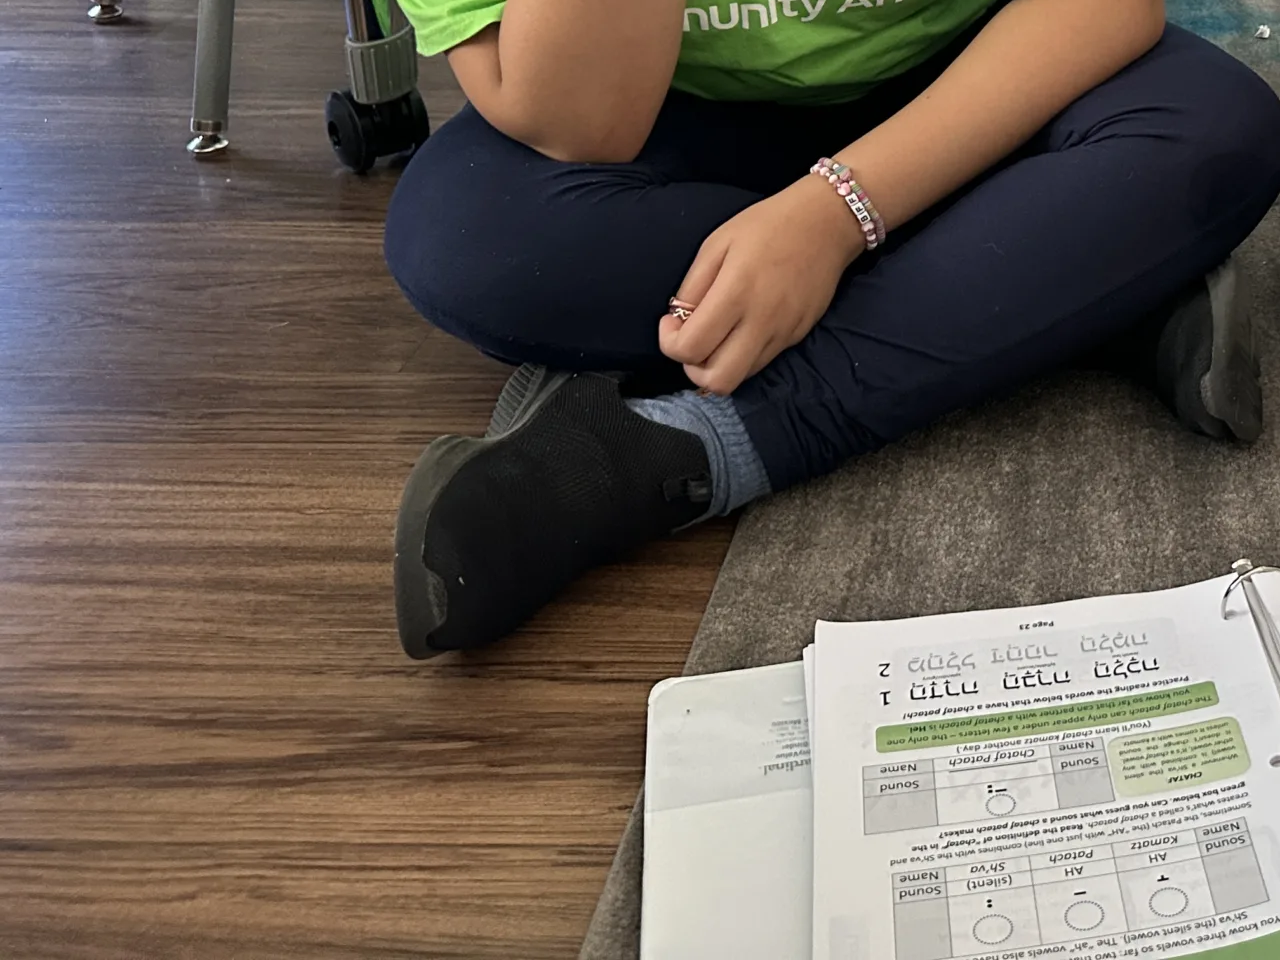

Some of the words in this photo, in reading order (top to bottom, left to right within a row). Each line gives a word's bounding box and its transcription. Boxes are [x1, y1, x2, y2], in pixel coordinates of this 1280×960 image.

[1032, 621, 1054, 629] Page
[878, 663, 890, 677] 2
[1152, 675, 1189, 687] Practice
[1097, 688, 1112, 696] the
[1114, 682, 1150, 693] reading
[880, 691, 892, 705] 1
[1033, 695, 1062, 704] below
[1065, 690, 1094, 700] words
[985, 702, 1009, 710] have
[1011, 700, 1031, 708] that
[903, 709, 940, 719] patach!
[942, 705, 974, 715] chataf
[1062, 729, 1093, 740] chataf
[1095, 726, 1120, 735] learn
[984, 739, 1021, 750] another
[1024, 736, 1059, 745] kamatz
[956, 744, 981, 753] day.)
[1059, 741, 1095, 752] Name
[949, 754, 991, 767] Patach
[994, 749, 1035, 761] Chataf
[764, 759, 812, 776] ardinal
[1060, 757, 1099, 769] Sound
[880, 764, 917, 774] Name
[1168, 772, 1202, 783] CHATAF
[880, 780, 919, 792] Sound
[1220, 781, 1245, 792] green
[1170, 793, 1200, 803] below.
[1202, 788, 1219, 798] box
[1217, 792, 1248, 804] creates
[1132, 801, 1149, 810] you
[1151, 799, 1168, 807] Can
[1080, 810, 1103, 818] what
[1105, 804, 1130, 814] guess
[1159, 806, 1184, 818] called
[1200, 802, 1252, 818] Sometimes,
[1050, 814, 1077, 823] sound
[1120, 812, 1149, 823] chataf
[1152, 817, 1182, 828] Patach
[1184, 815, 1199, 823] the
[976, 822, 1008, 834] patach
[1010, 819, 1040, 830] chataf
[1061, 823, 1083, 832] Read
[1132, 822, 1150, 831] (the
[1202, 822, 1240, 837] Name
[939, 827, 974, 839] makes?
[995, 829, 1040, 841] definition
[1042, 826, 1057, 835] the
[1084, 831, 1105, 840] with
[983, 836, 993, 844] of
[1046, 837, 1064, 845] one
[1066, 833, 1082, 842] just
[1131, 835, 1178, 851] Kamatz
[911, 845, 927, 853] the
[978, 843, 1022, 854] combines
[1024, 838, 1044, 849] line)
[1205, 835, 1246, 852] Sound
[937, 852, 952, 860] the
[955, 849, 975, 858] with
[1049, 850, 1094, 864] Patach
[1148, 852, 1167, 863] AH
[890, 857, 907, 866] and
[1064, 866, 1083, 876] AH
[899, 871, 939, 884] Name
[967, 874, 1012, 891] (silent)
[899, 886, 942, 900] Sound
[1194, 918, 1216, 930] (the
[1260, 915, 1280, 927] You
[1163, 922, 1192, 936] silent
[1229, 922, 1258, 935] know
[1120, 929, 1160, 943] vowel).
[1197, 930, 1226, 943] three
[1097, 937, 1117, 948] The
[1156, 937, 1194, 952] vowels
[1028, 946, 1066, 957] vowels
[1142, 946, 1154, 954] so
[1004, 952, 1025, 960] also
[1095, 952, 1116, 960] two
